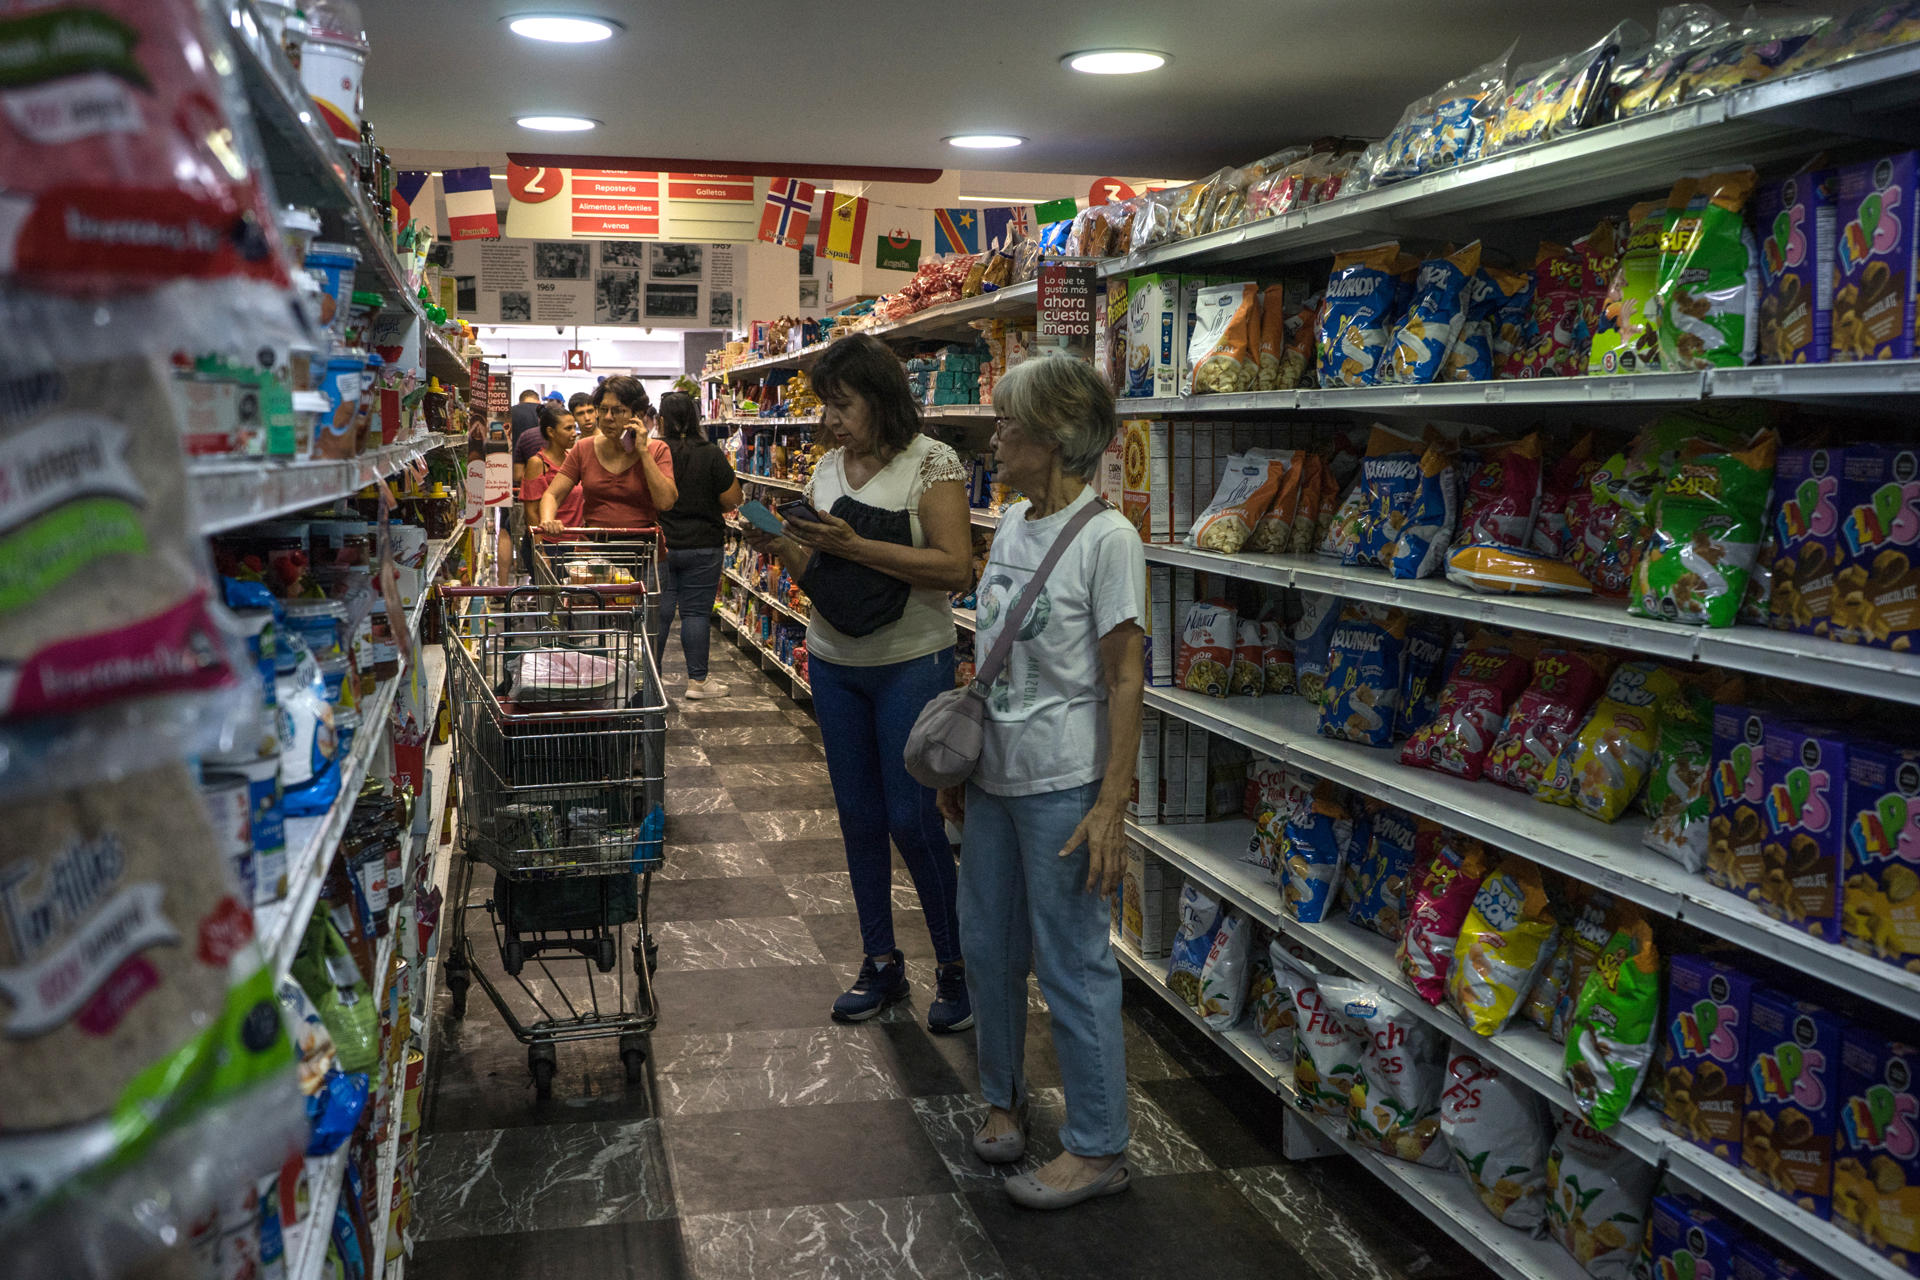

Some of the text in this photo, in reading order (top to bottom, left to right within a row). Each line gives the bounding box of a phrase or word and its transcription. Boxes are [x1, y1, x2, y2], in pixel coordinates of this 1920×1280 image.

[524, 167, 546, 194] 2
[595, 184, 637, 193] Repostería
[696, 188, 727, 197] Galletas
[579, 203, 653, 213] Alimentos infantiles
[602, 222, 630, 230] Avenas
[822, 246, 854, 260] España
[537, 283, 555, 291] 1969
[1044, 275, 1086, 288] Lo que te
[1044, 286, 1089, 296] gusta más
[1043, 294, 1086, 309] ahora
[1043, 309, 1090, 322] cuesta
[1043, 323, 1090, 335] menos
[570, 352, 582, 367] 4
